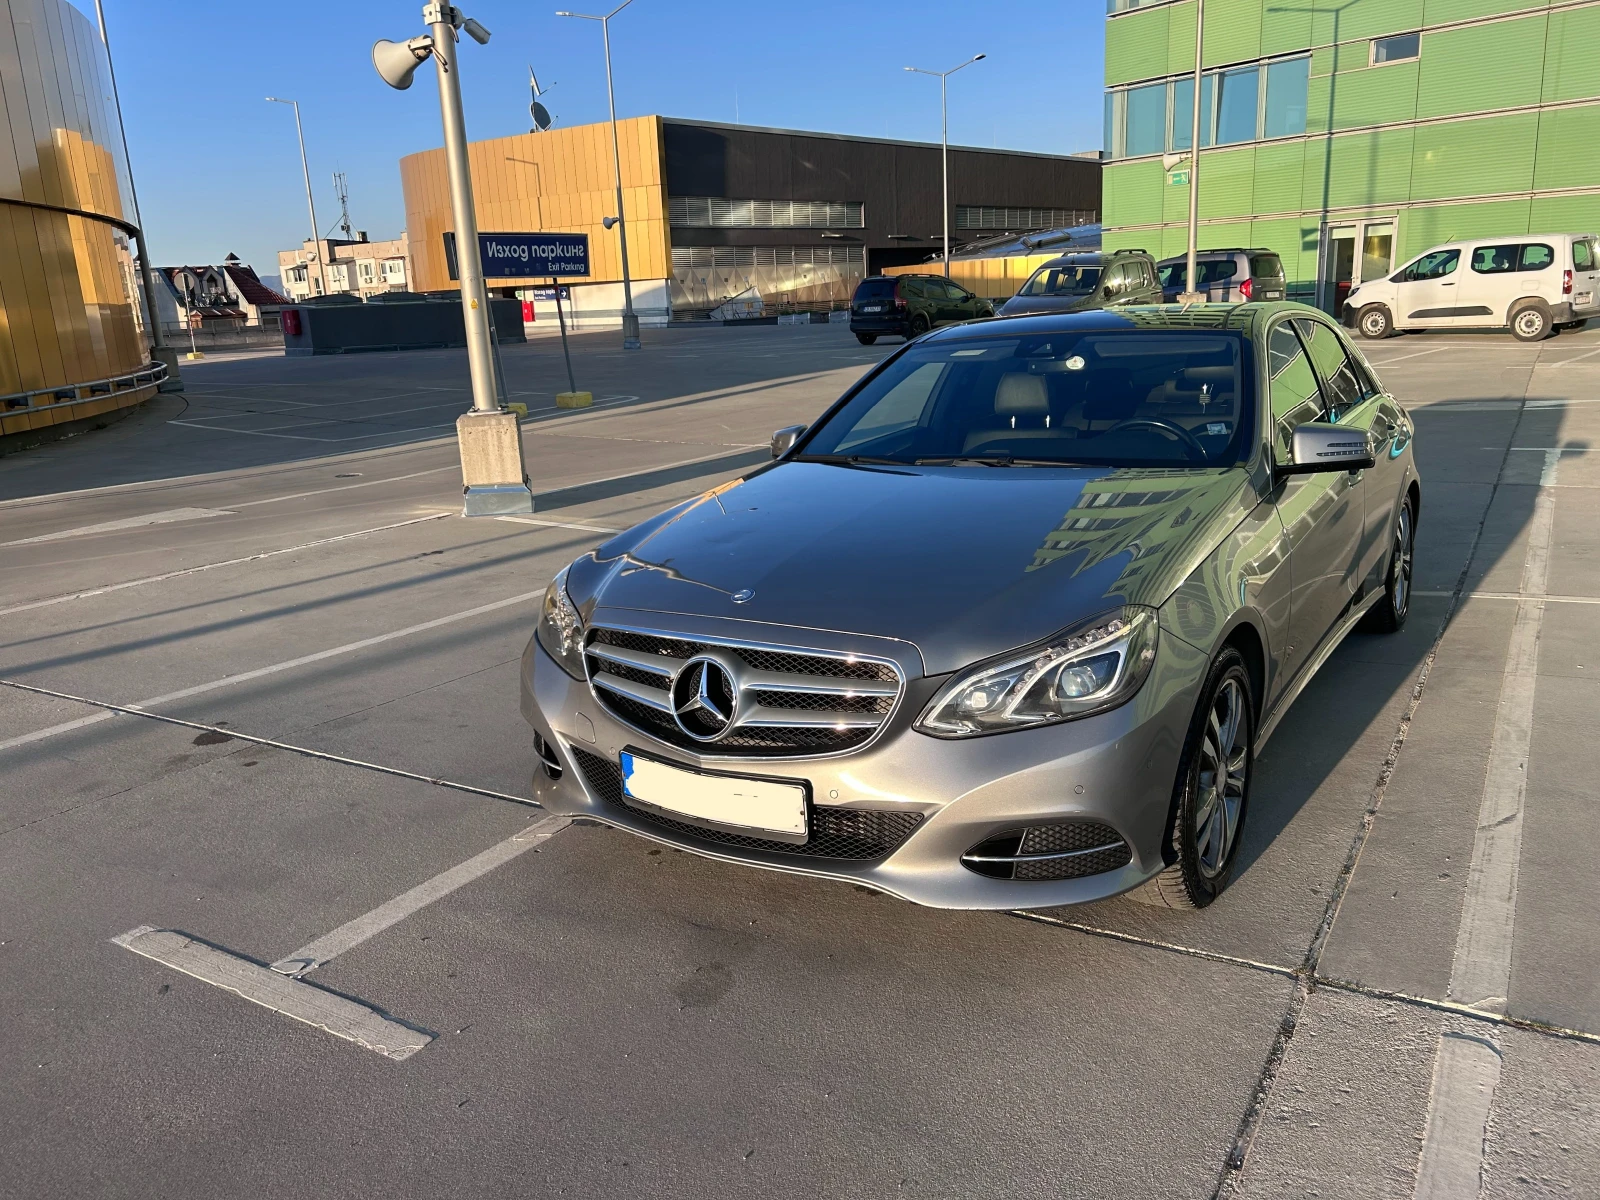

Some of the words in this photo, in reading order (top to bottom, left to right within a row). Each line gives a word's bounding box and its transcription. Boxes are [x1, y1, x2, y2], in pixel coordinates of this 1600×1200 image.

[486, 241, 529, 261] Изход
[532, 242, 584, 260] паркинг
[548, 263, 560, 272] Exit
[561, 262, 585, 272] Parking
